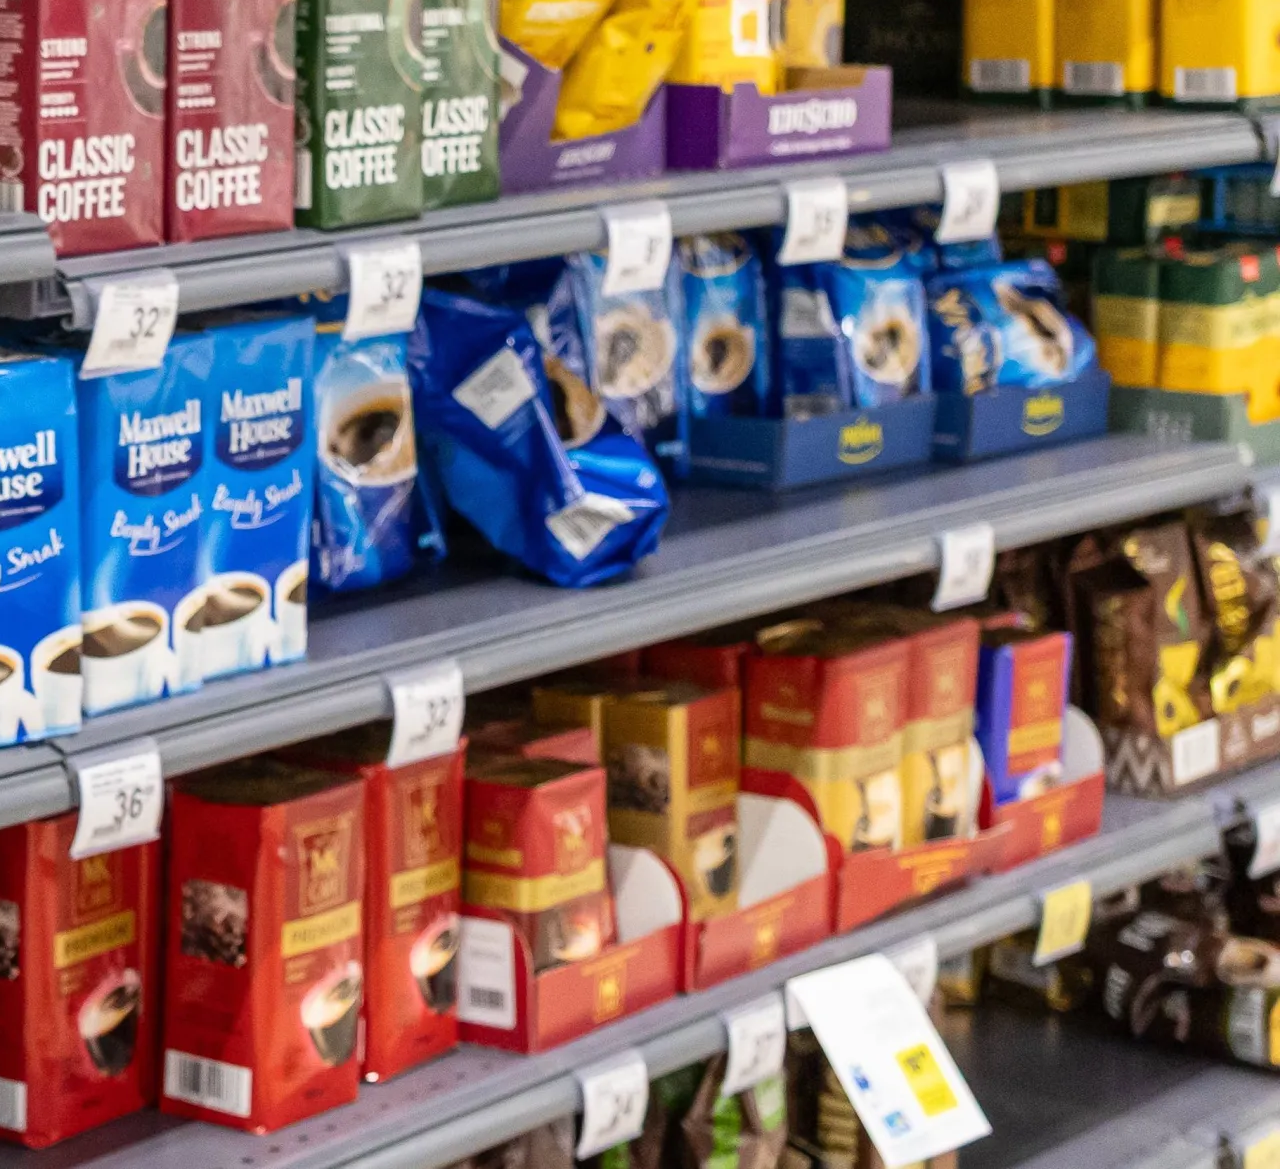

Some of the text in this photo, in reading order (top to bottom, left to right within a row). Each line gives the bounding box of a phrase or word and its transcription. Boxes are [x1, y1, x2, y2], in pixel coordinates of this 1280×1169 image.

[176, 123, 269, 169] CLASSIC
[325, 104, 405, 148] CLASSIC
[39, 133, 136, 180] CLASSIC
[325, 144, 398, 189] COFFEE
[38, 177, 127, 223] COFFEE
[176, 165, 262, 211] COFFEE
[130, 306, 160, 339] 32
[119, 399, 201, 446] Maxwell
[220, 378, 303, 423] Maxwell
[229, 417, 294, 454] House
[127, 439, 192, 479] House
[114, 787, 143, 826] 36
